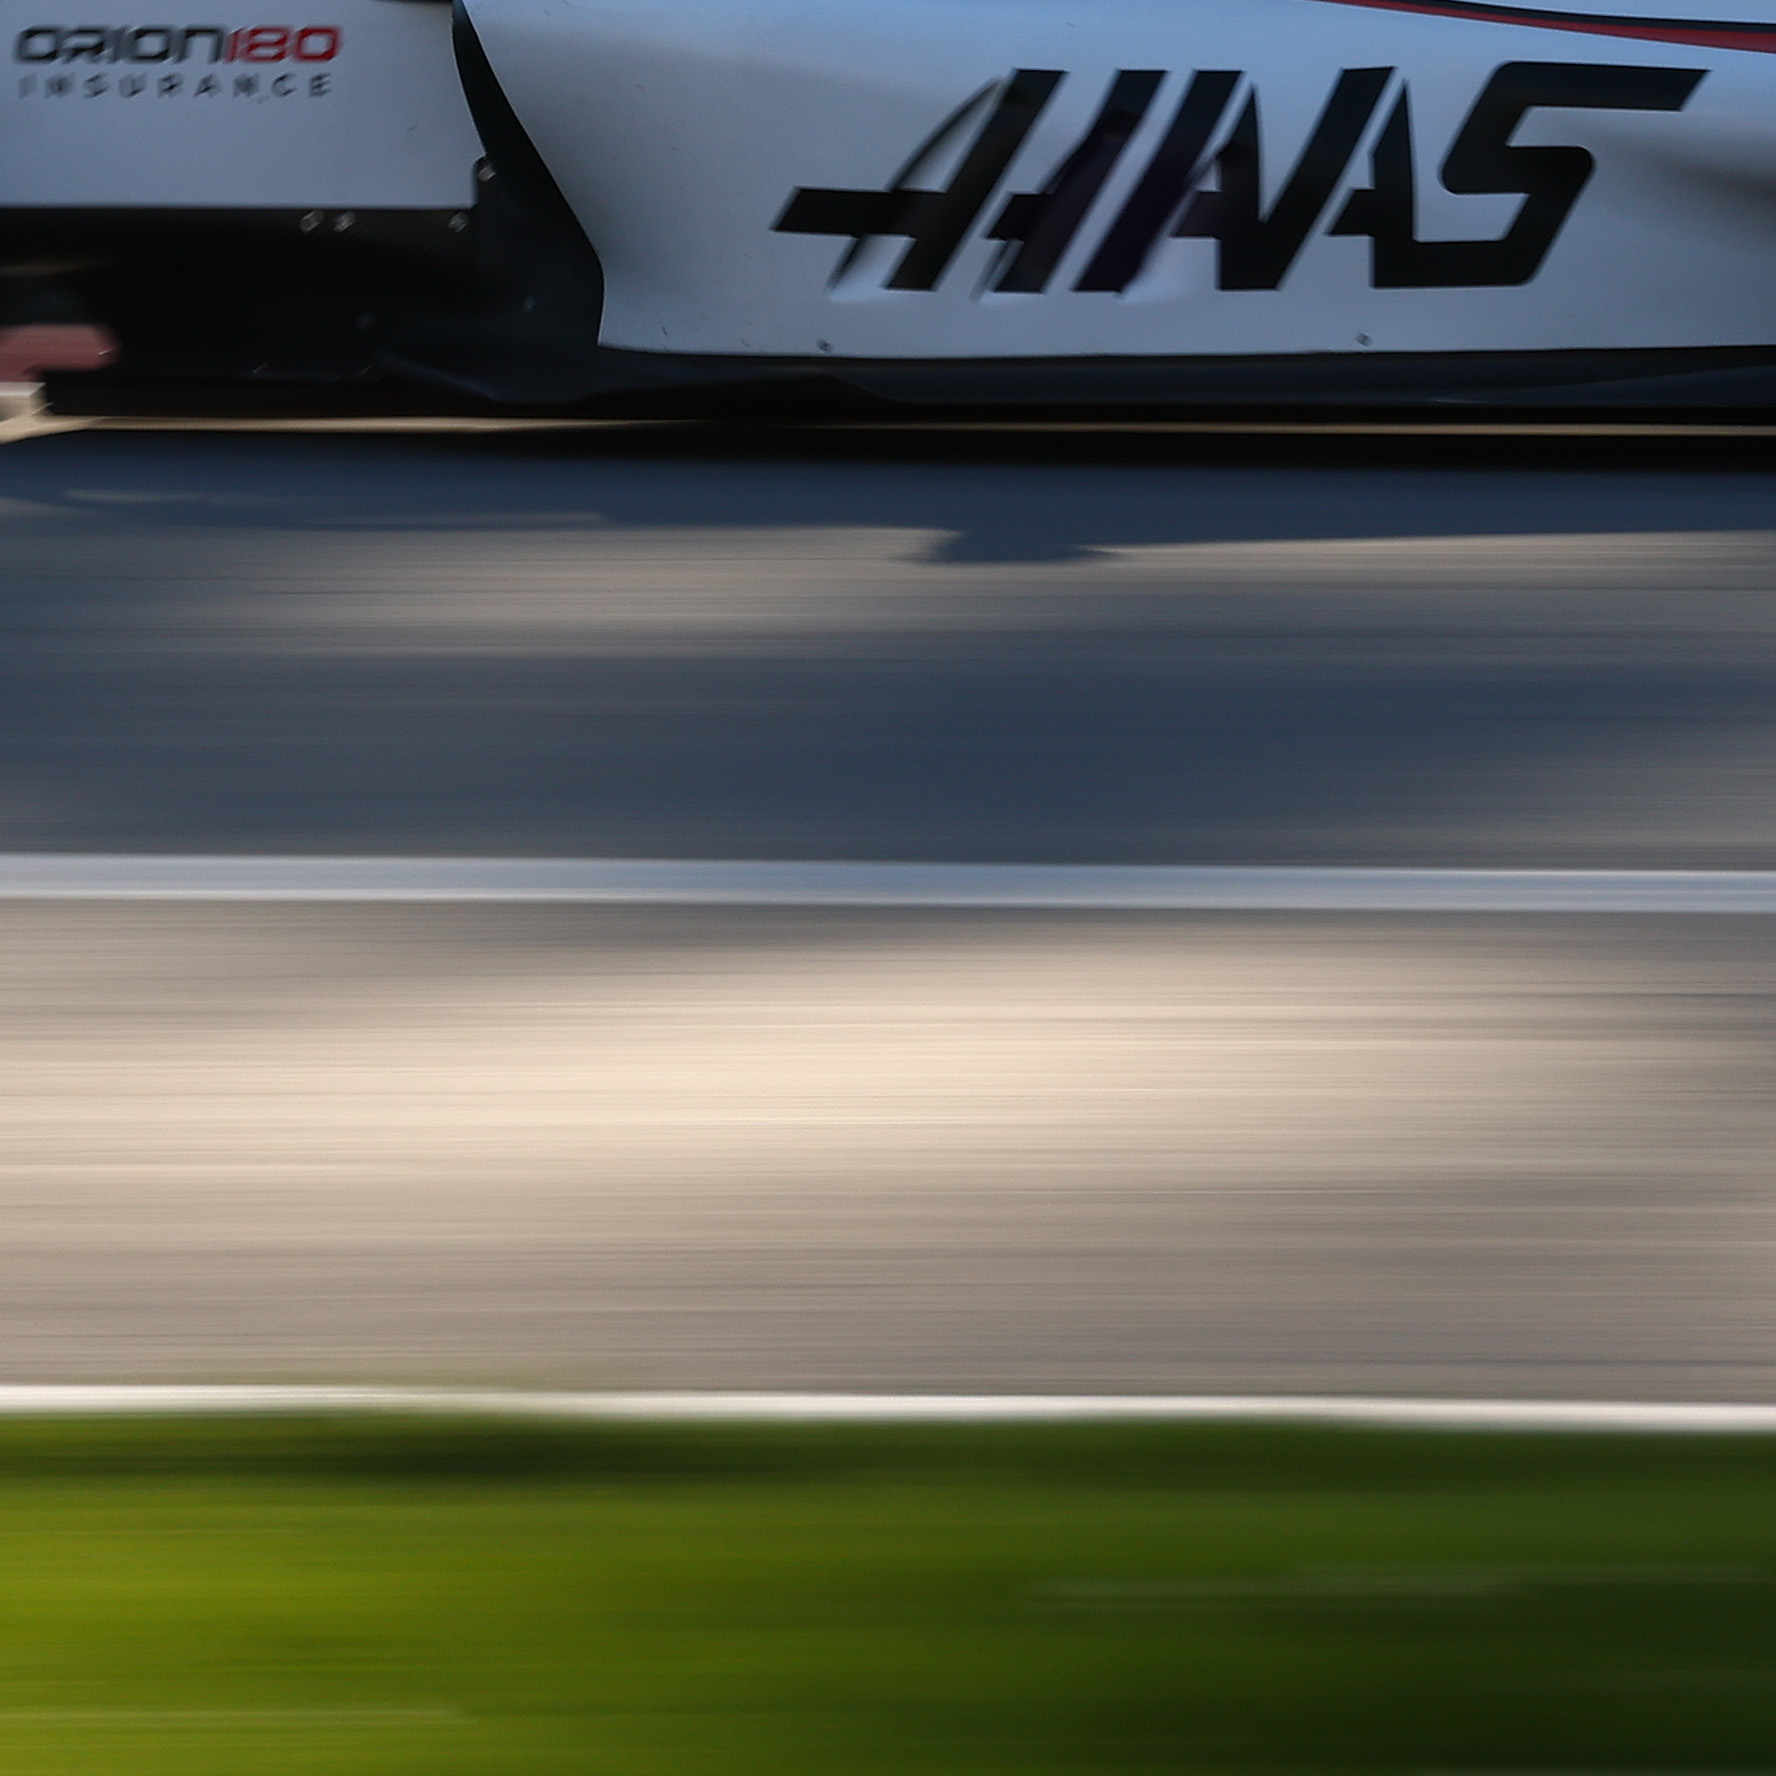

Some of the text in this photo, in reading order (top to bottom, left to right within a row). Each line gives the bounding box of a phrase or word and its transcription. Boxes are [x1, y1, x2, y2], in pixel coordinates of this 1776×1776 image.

[14, 26, 341, 65] ORION180
[19, 72, 333, 100] INSURANCE
[771, 61, 1712, 295] HAAS
